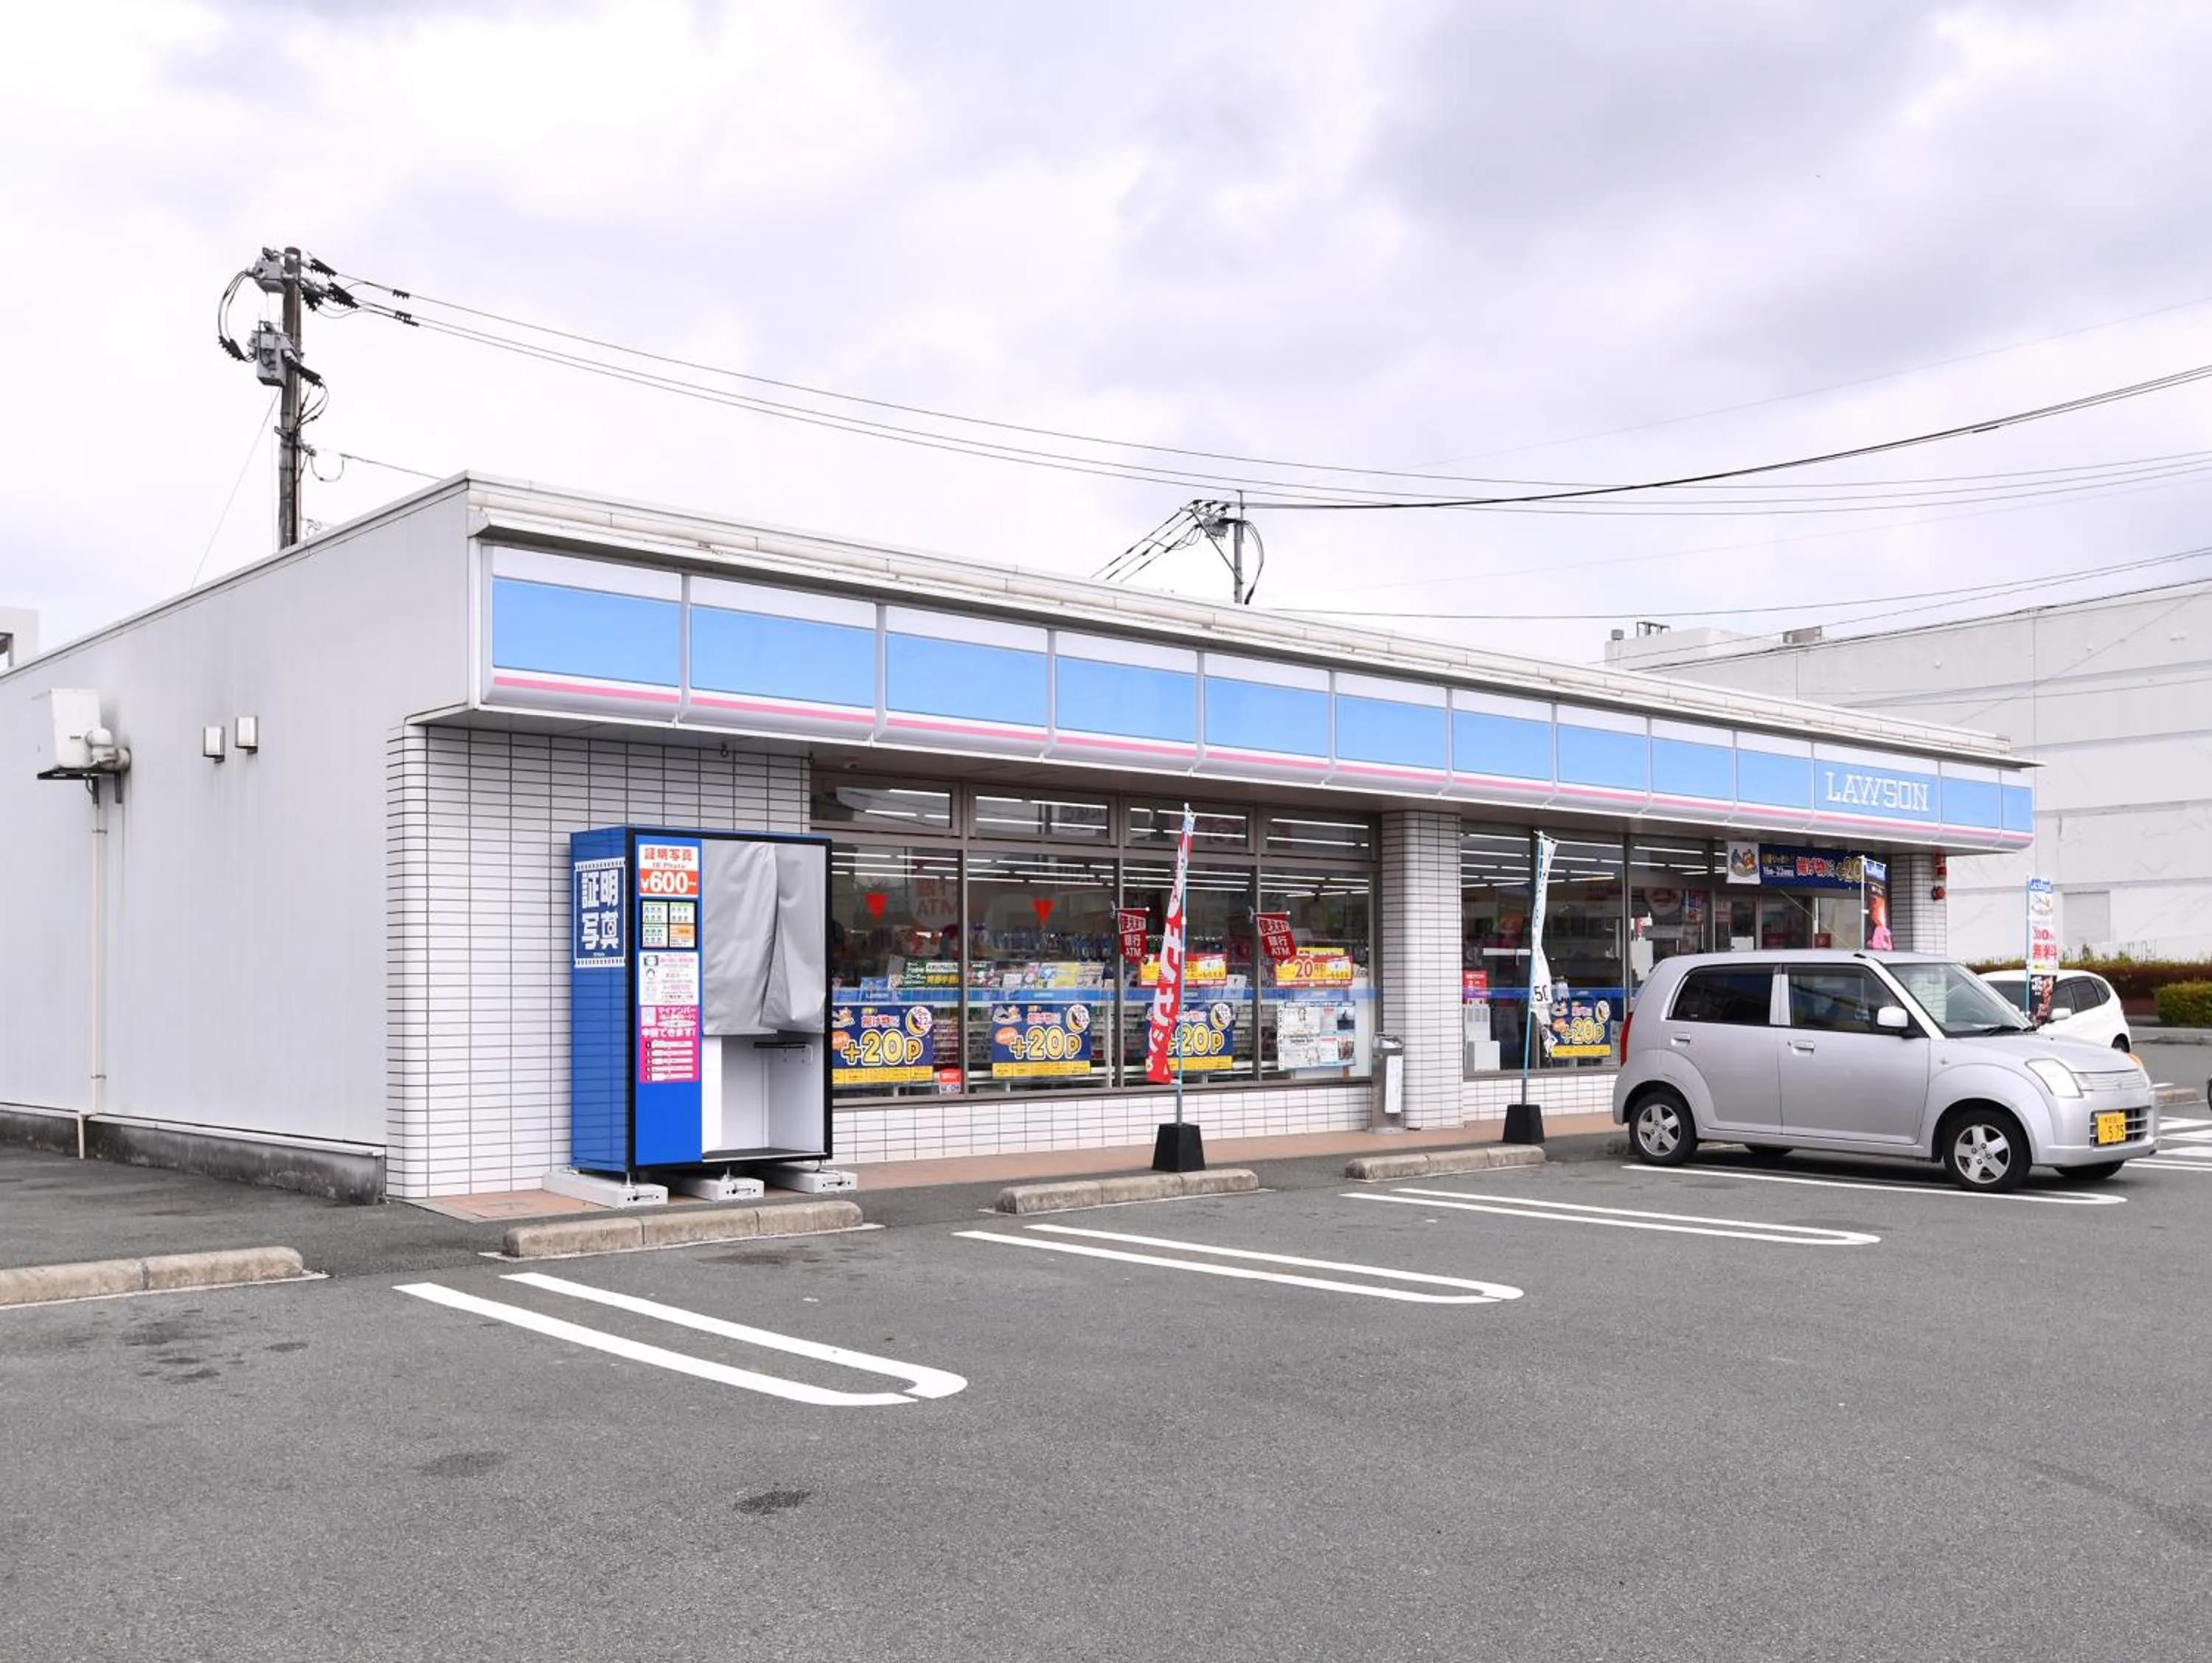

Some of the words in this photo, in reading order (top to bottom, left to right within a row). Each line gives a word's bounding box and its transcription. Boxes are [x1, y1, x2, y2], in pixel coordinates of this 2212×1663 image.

[1825, 771, 1929, 811] LAWSON
[644, 847, 692, 861] 証明写真
